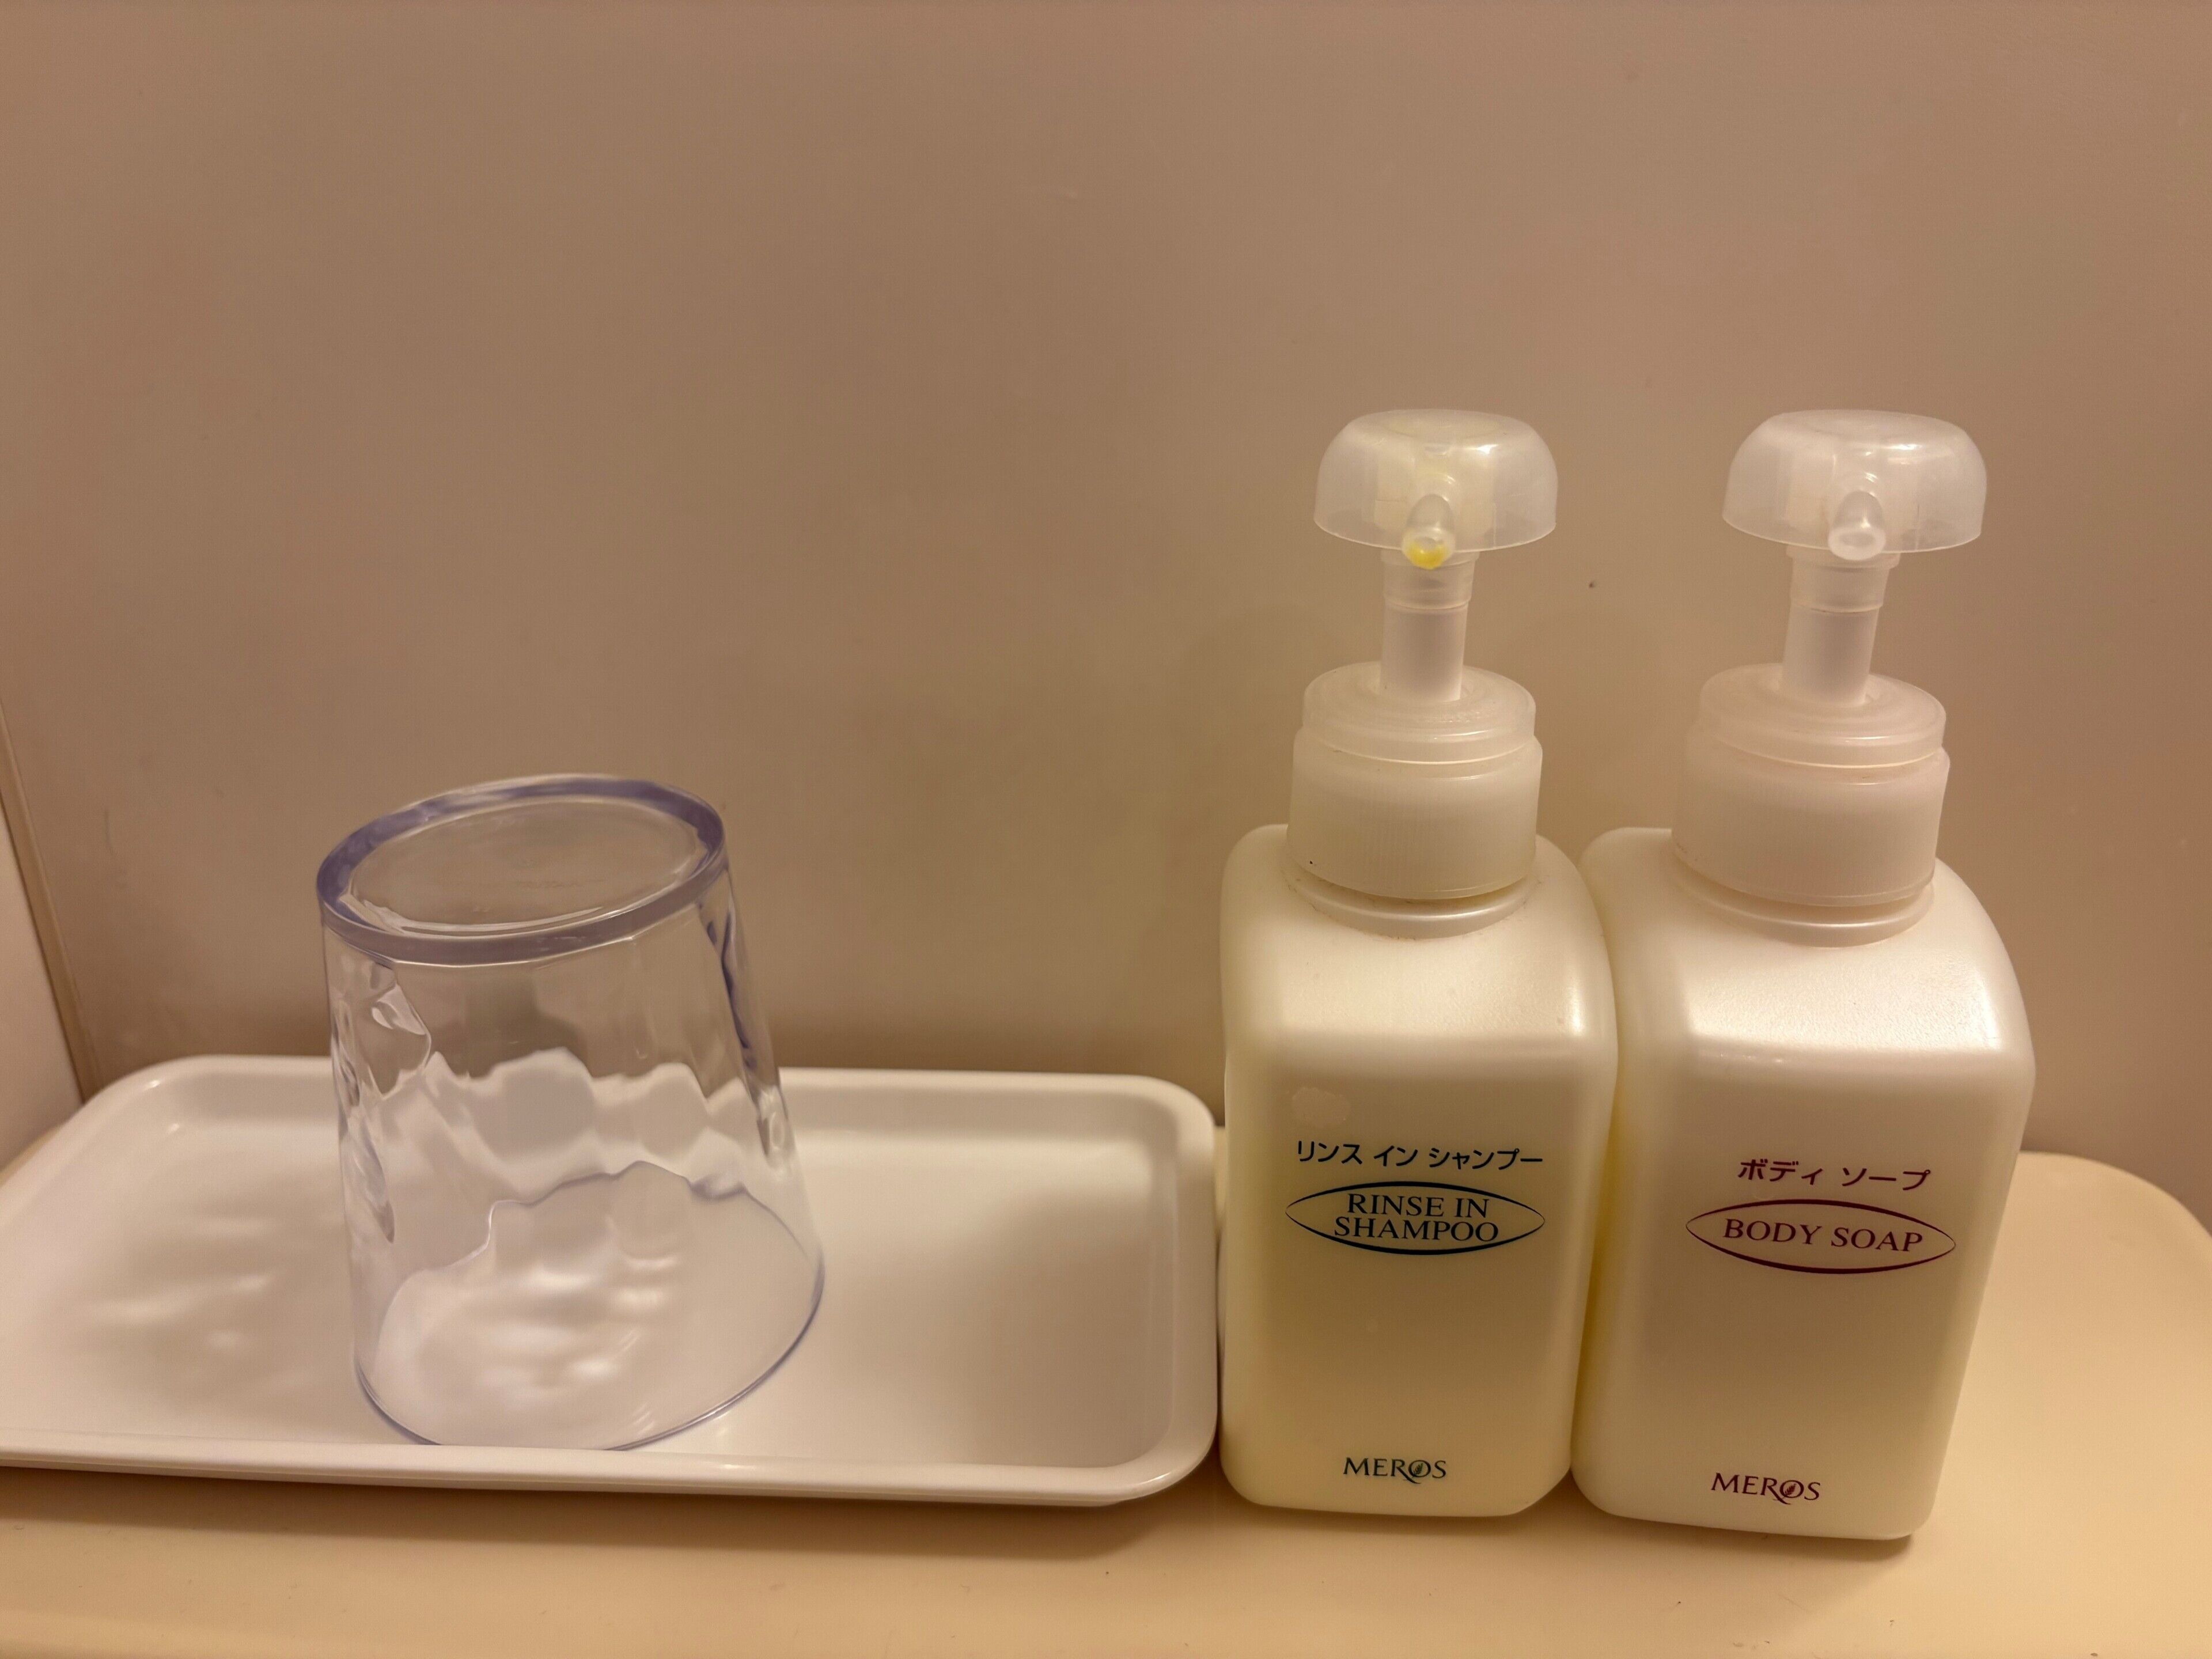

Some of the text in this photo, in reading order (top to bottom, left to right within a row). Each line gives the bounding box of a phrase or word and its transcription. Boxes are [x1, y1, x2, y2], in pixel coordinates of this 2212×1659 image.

[1297, 1140, 1543, 1170] リンス イン シャンプー
[1737, 1158, 1931, 1191] ボディ ソープ
[1347, 1193, 1490, 1218] RINSE IN
[1334, 1216, 1499, 1242] SHAMPOO
[1722, 1218, 1923, 1252] BODY SOAP
[1343, 1457, 1446, 1484] MEROS
[1710, 1472, 1821, 1505] MEROS
